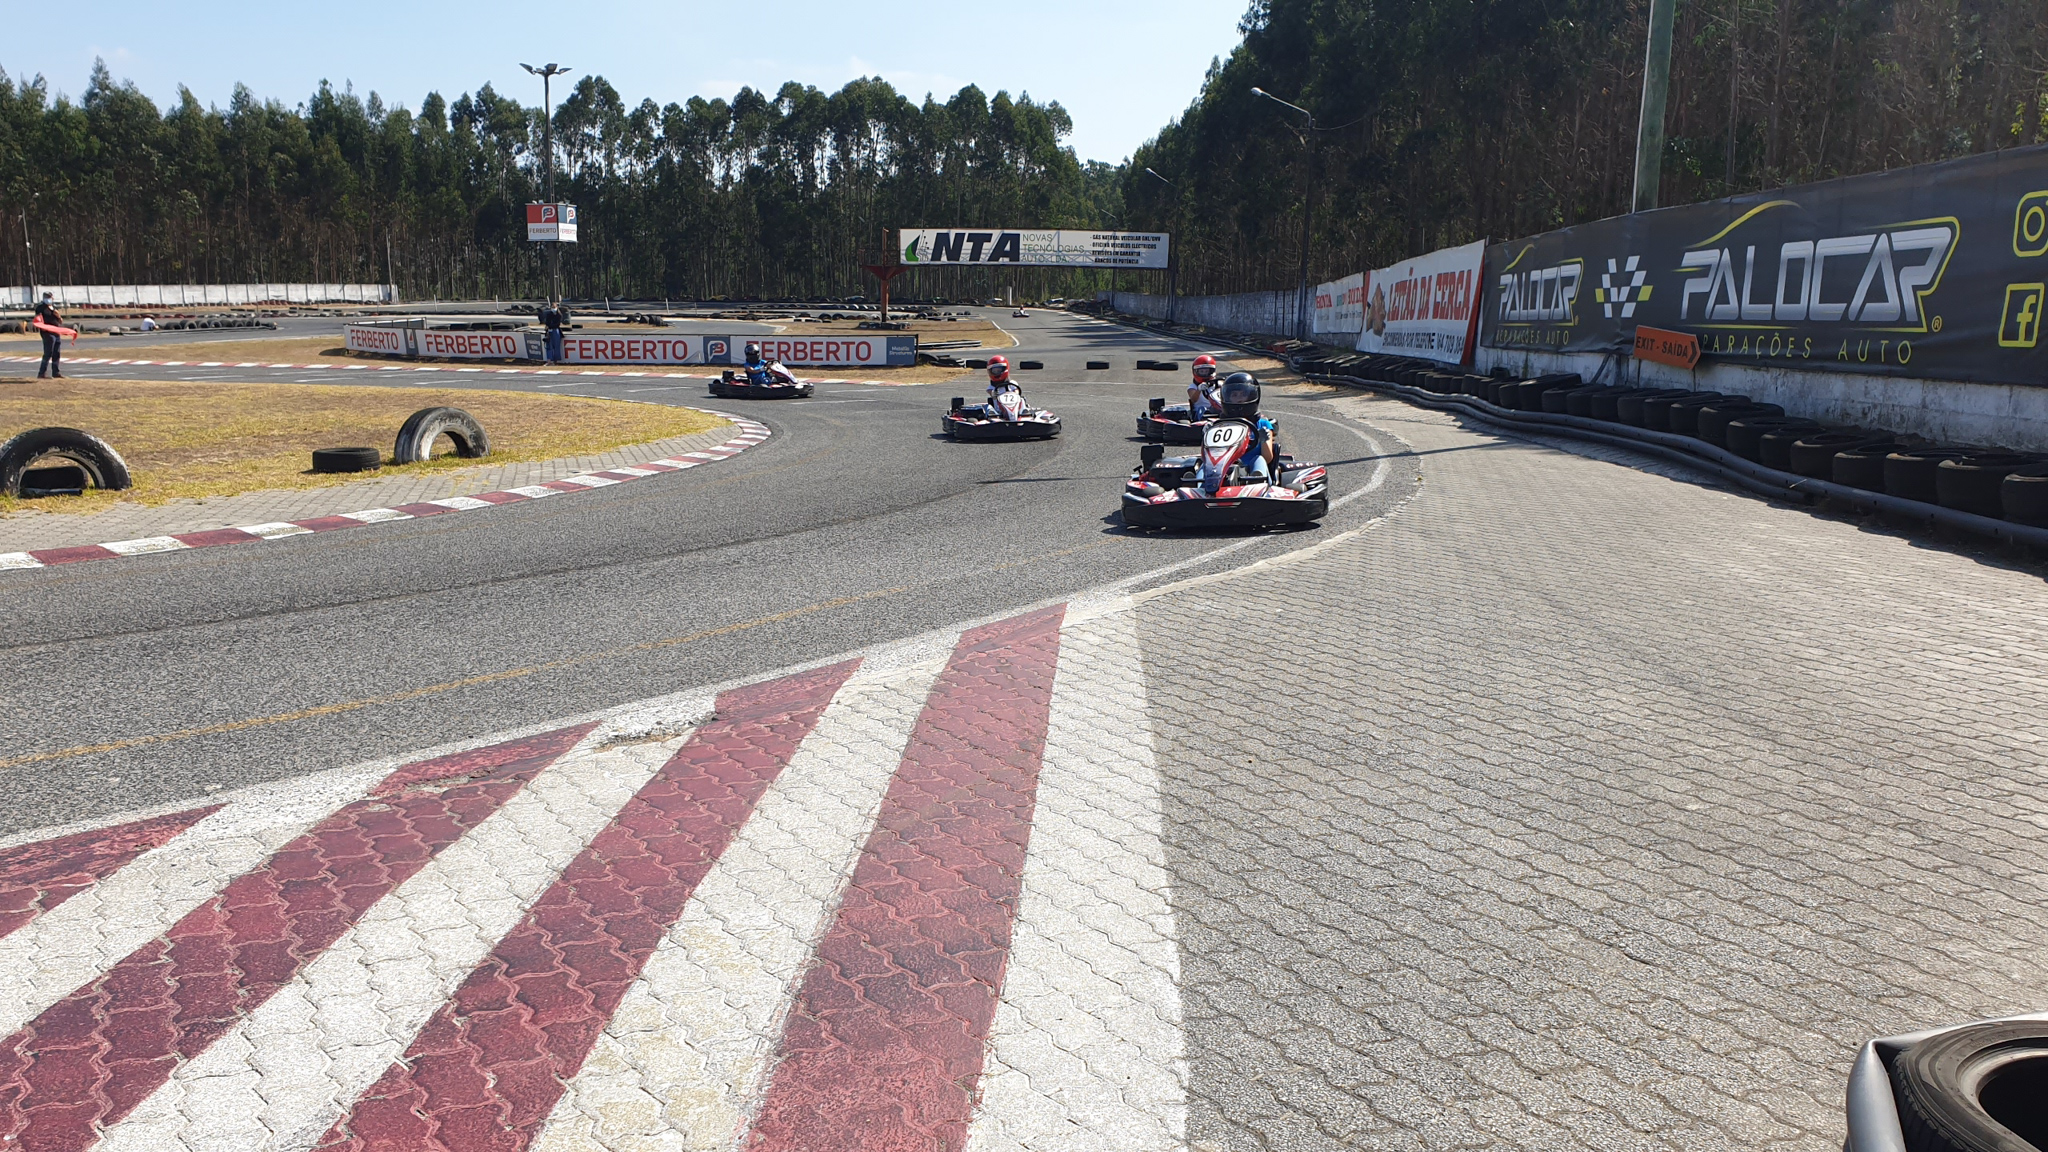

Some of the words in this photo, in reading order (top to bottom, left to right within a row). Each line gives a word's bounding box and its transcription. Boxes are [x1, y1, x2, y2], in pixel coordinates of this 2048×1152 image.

[930, 232, 1021, 262] NTA
[1022, 233, 1053, 242] NOVAS
[1022, 243, 1084, 253] TECNOLOGIAS
[1680, 227, 1951, 322] PALOCAR
[1387, 267, 1418, 321] LEITÃO
[1417, 275, 1433, 321] DA
[1432, 269, 1472, 321] CERCA
[1499, 264, 1581, 320] PALOCAR
[350, 329, 399, 350] FERBERTO
[425, 334, 517, 354] FERBERTO
[1545, 330, 1569, 345] AUTO
[1636, 336, 1655, 350] EXIT
[1661, 341, 1688, 358] SAÍDA
[1702, 332, 1812, 359] PARAÇÕES
[1838, 339, 1912, 364] AUTO
[564, 339, 688, 360] FERBERTO
[1212, 428, 1233, 443] 60
